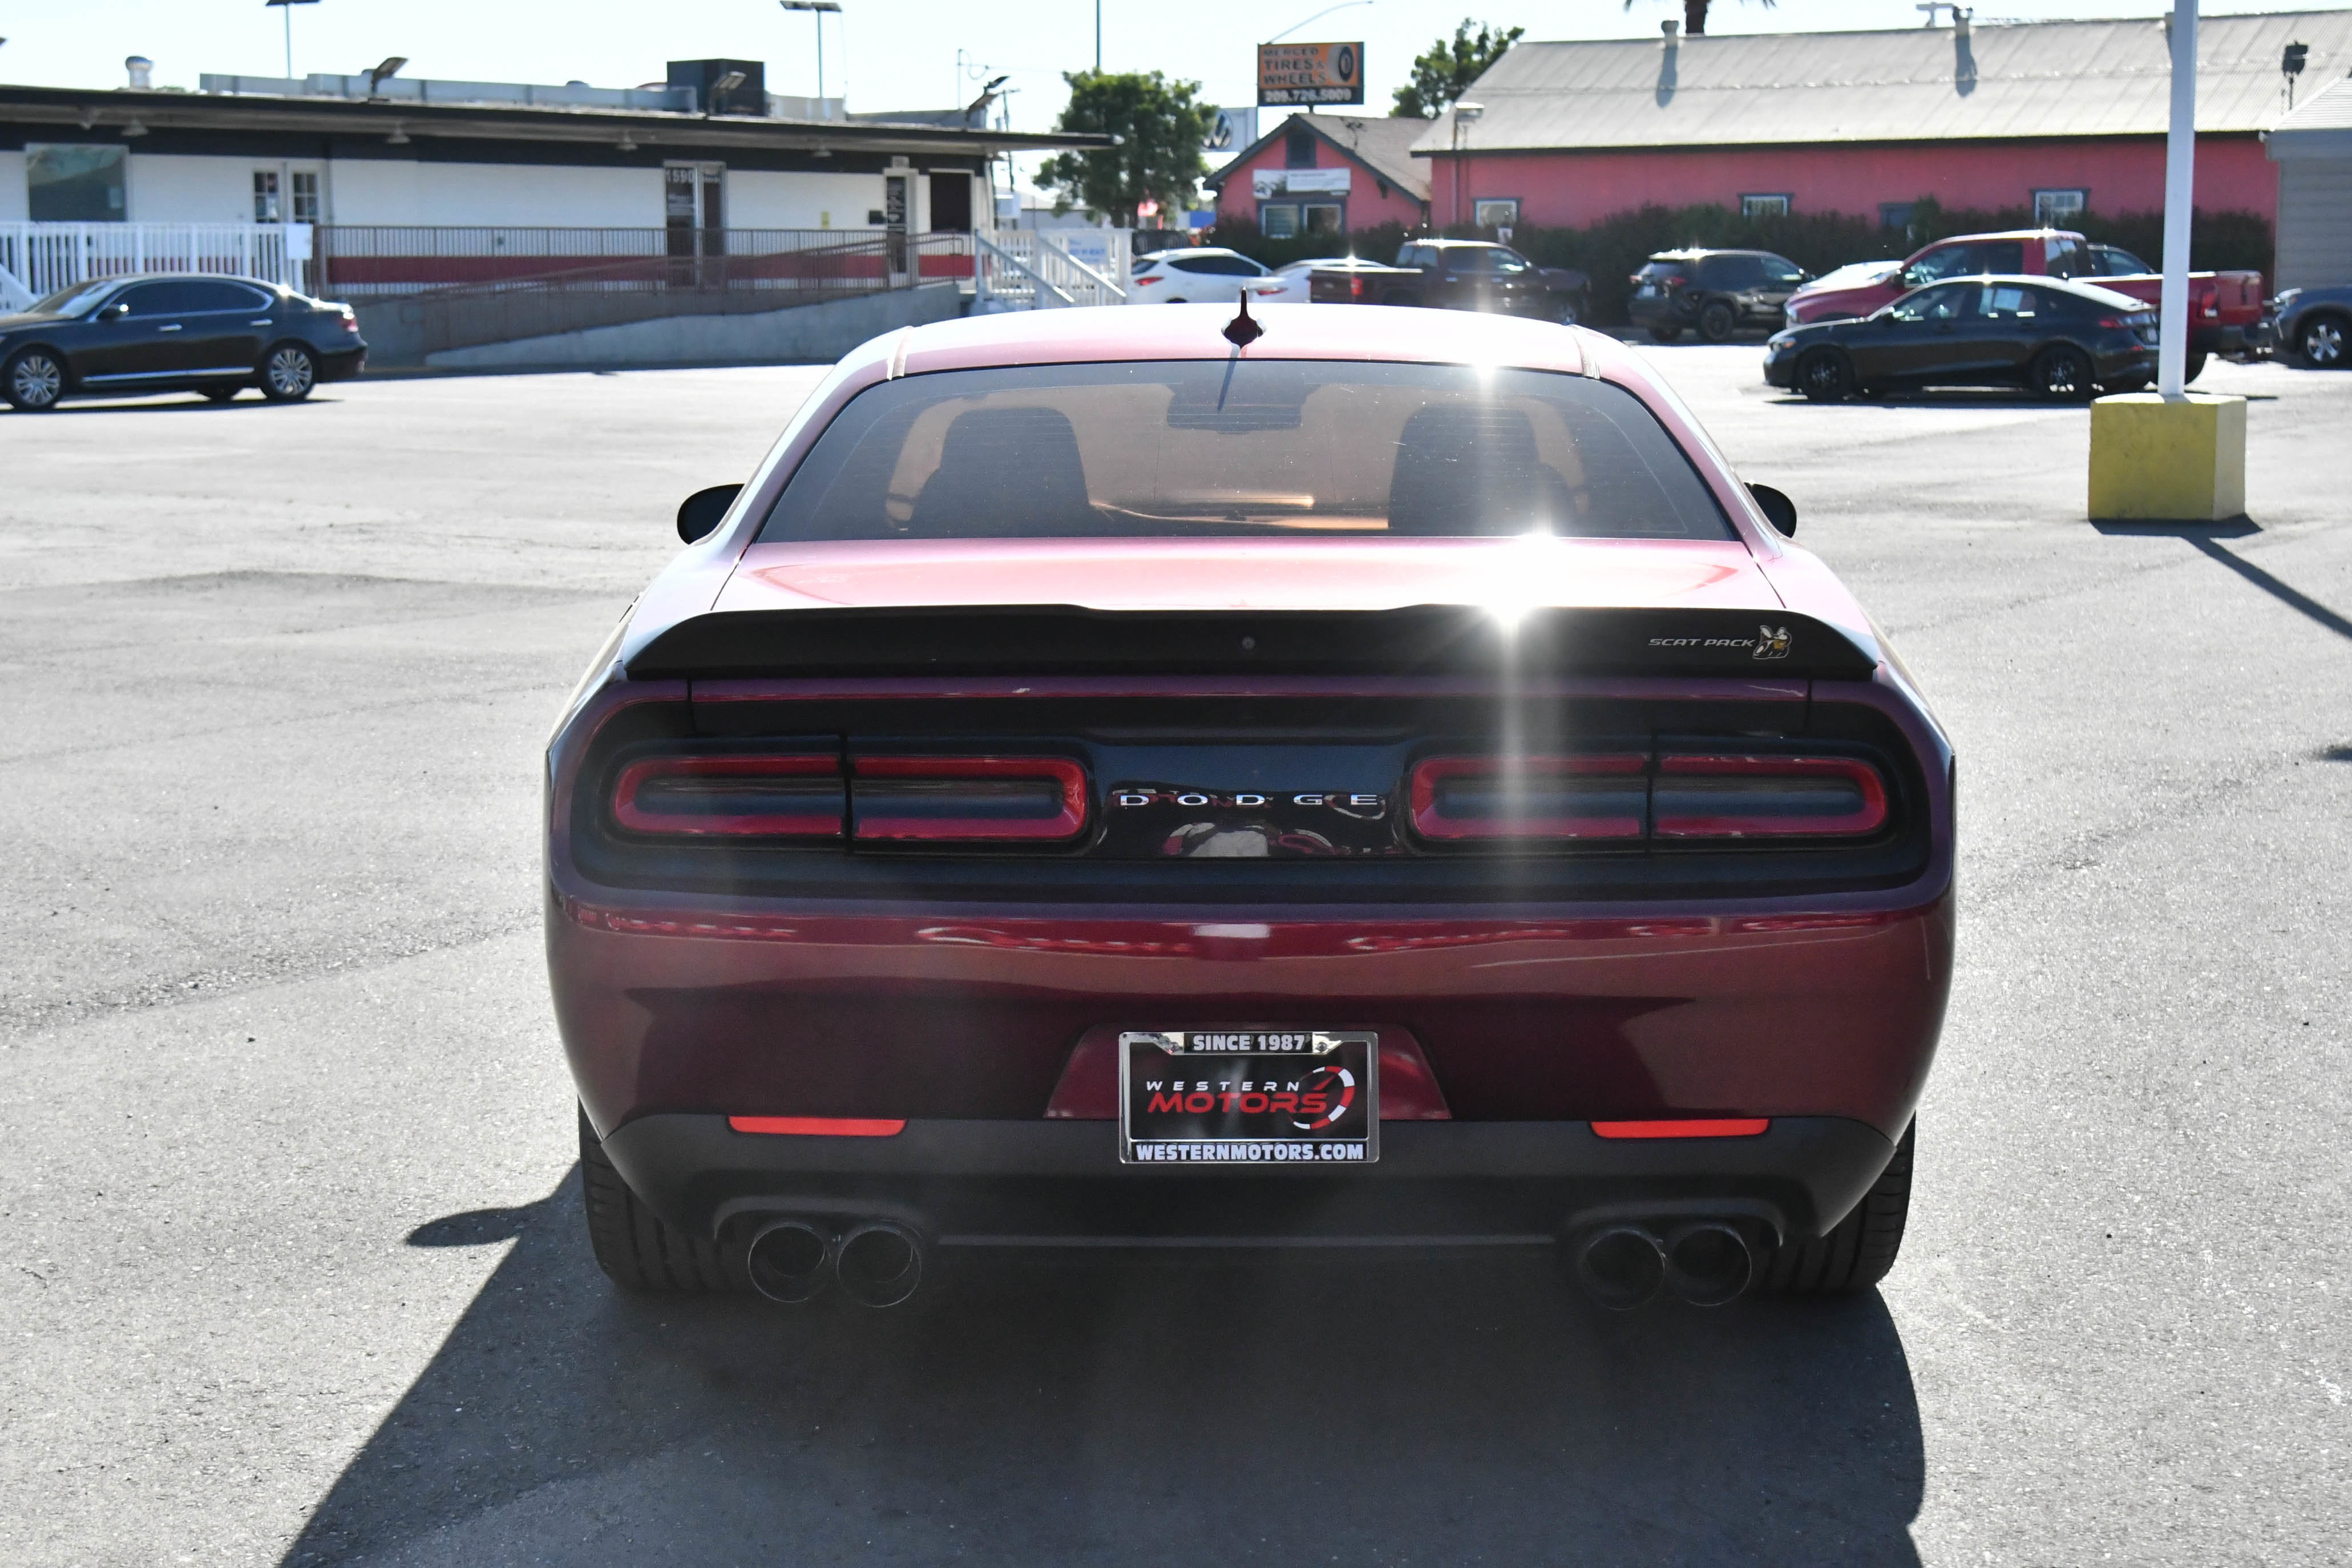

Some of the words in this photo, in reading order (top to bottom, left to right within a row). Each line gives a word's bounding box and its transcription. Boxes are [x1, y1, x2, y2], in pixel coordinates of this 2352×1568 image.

[1264, 58, 1314, 71] TIRES
[1263, 72, 1327, 85] WHEELS
[1648, 638, 1701, 646] SCAT
[1703, 638, 1755, 647] PACK
[1120, 794, 1378, 806] DODGE
[1193, 1034, 1250, 1050] SINCE
[1258, 1034, 1305, 1050] 1987
[1146, 1081, 1301, 1091] WESTERN
[1147, 1092, 1327, 1114] MOTORS
[1136, 1143, 1364, 1161] WESTERNMOTORS.COM
